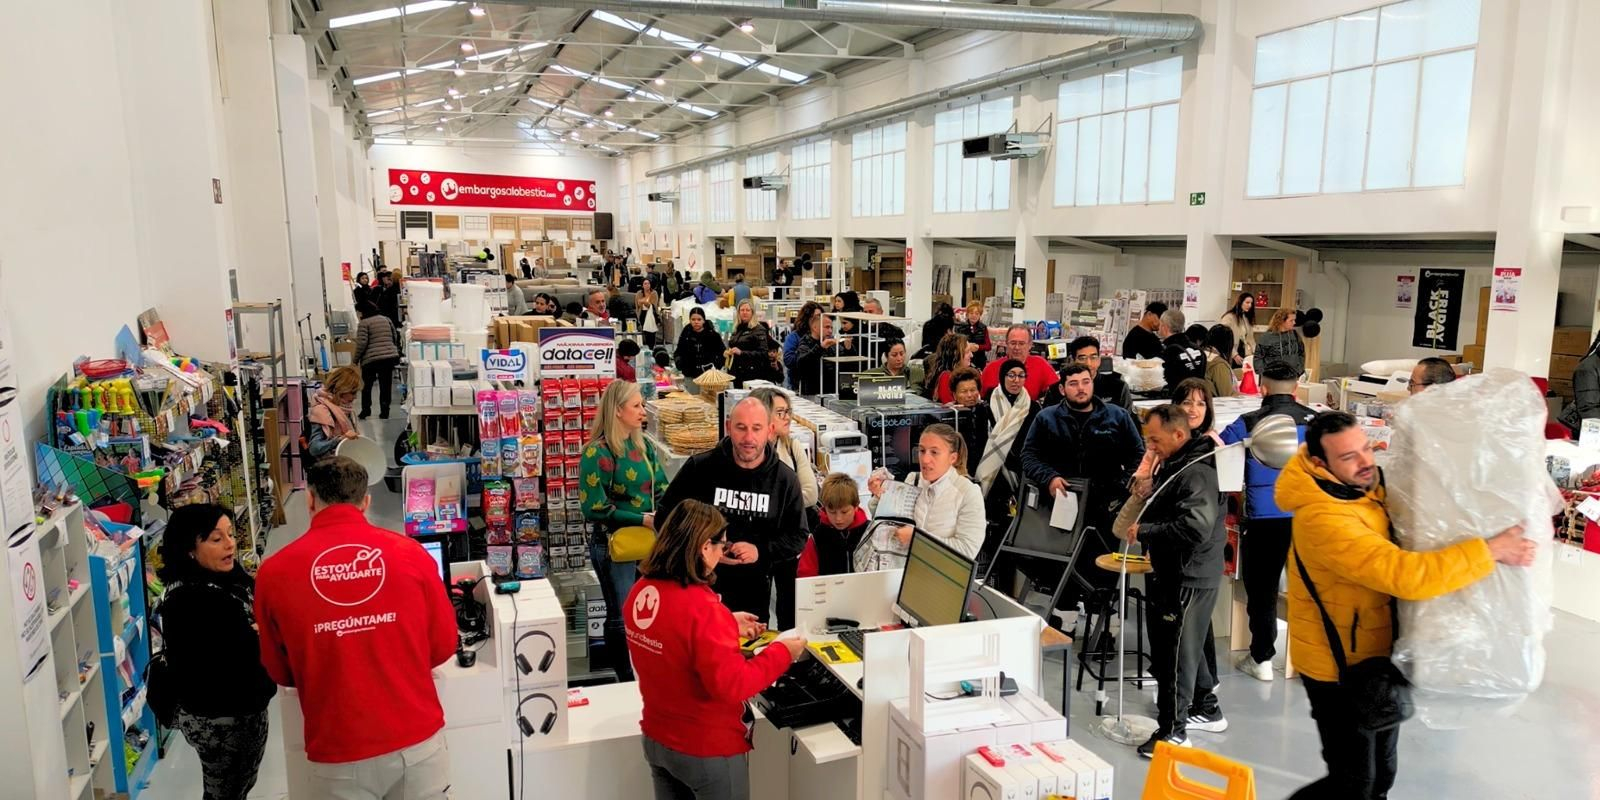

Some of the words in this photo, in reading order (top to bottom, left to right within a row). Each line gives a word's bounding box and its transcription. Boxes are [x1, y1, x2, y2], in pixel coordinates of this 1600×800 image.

[458, 184, 557, 199] embargosalobestia.com
[1425, 289, 1439, 339] BLACK
[1436, 289, 1449, 343] FRIDAY
[542, 348, 614, 361] datacell
[489, 358, 521, 367] VIDAL
[877, 392, 903, 400] FRIDAY
[713, 487, 770, 513] PUMA
[314, 562, 352, 576] ESTOY
[329, 567, 382, 582] AYUDARTE
[313, 611, 397, 634] ¡PREGÚNTAME!
